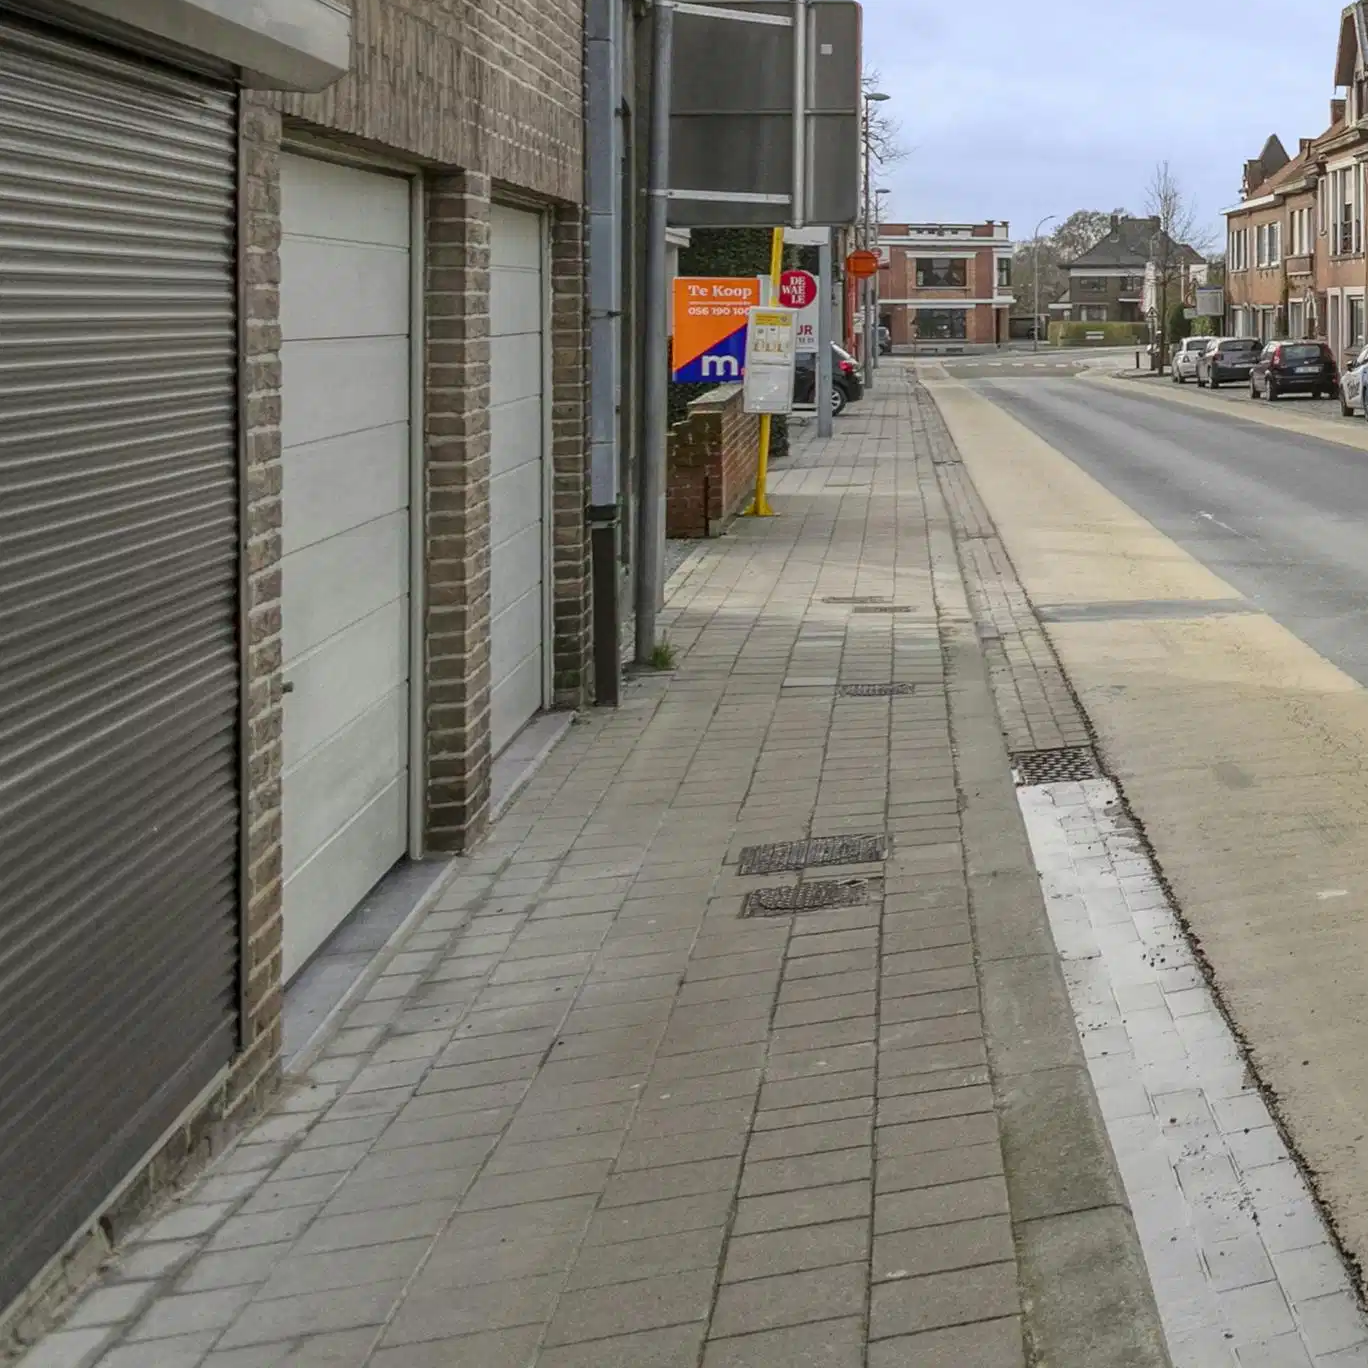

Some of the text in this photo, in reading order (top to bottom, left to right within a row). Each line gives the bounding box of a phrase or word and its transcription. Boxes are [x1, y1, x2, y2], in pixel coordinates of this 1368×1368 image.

[790, 276, 805, 286] DE
[688, 285, 752, 299] Te Koop
[782, 285, 805, 295] WAE
[791, 294, 805, 304] LE
